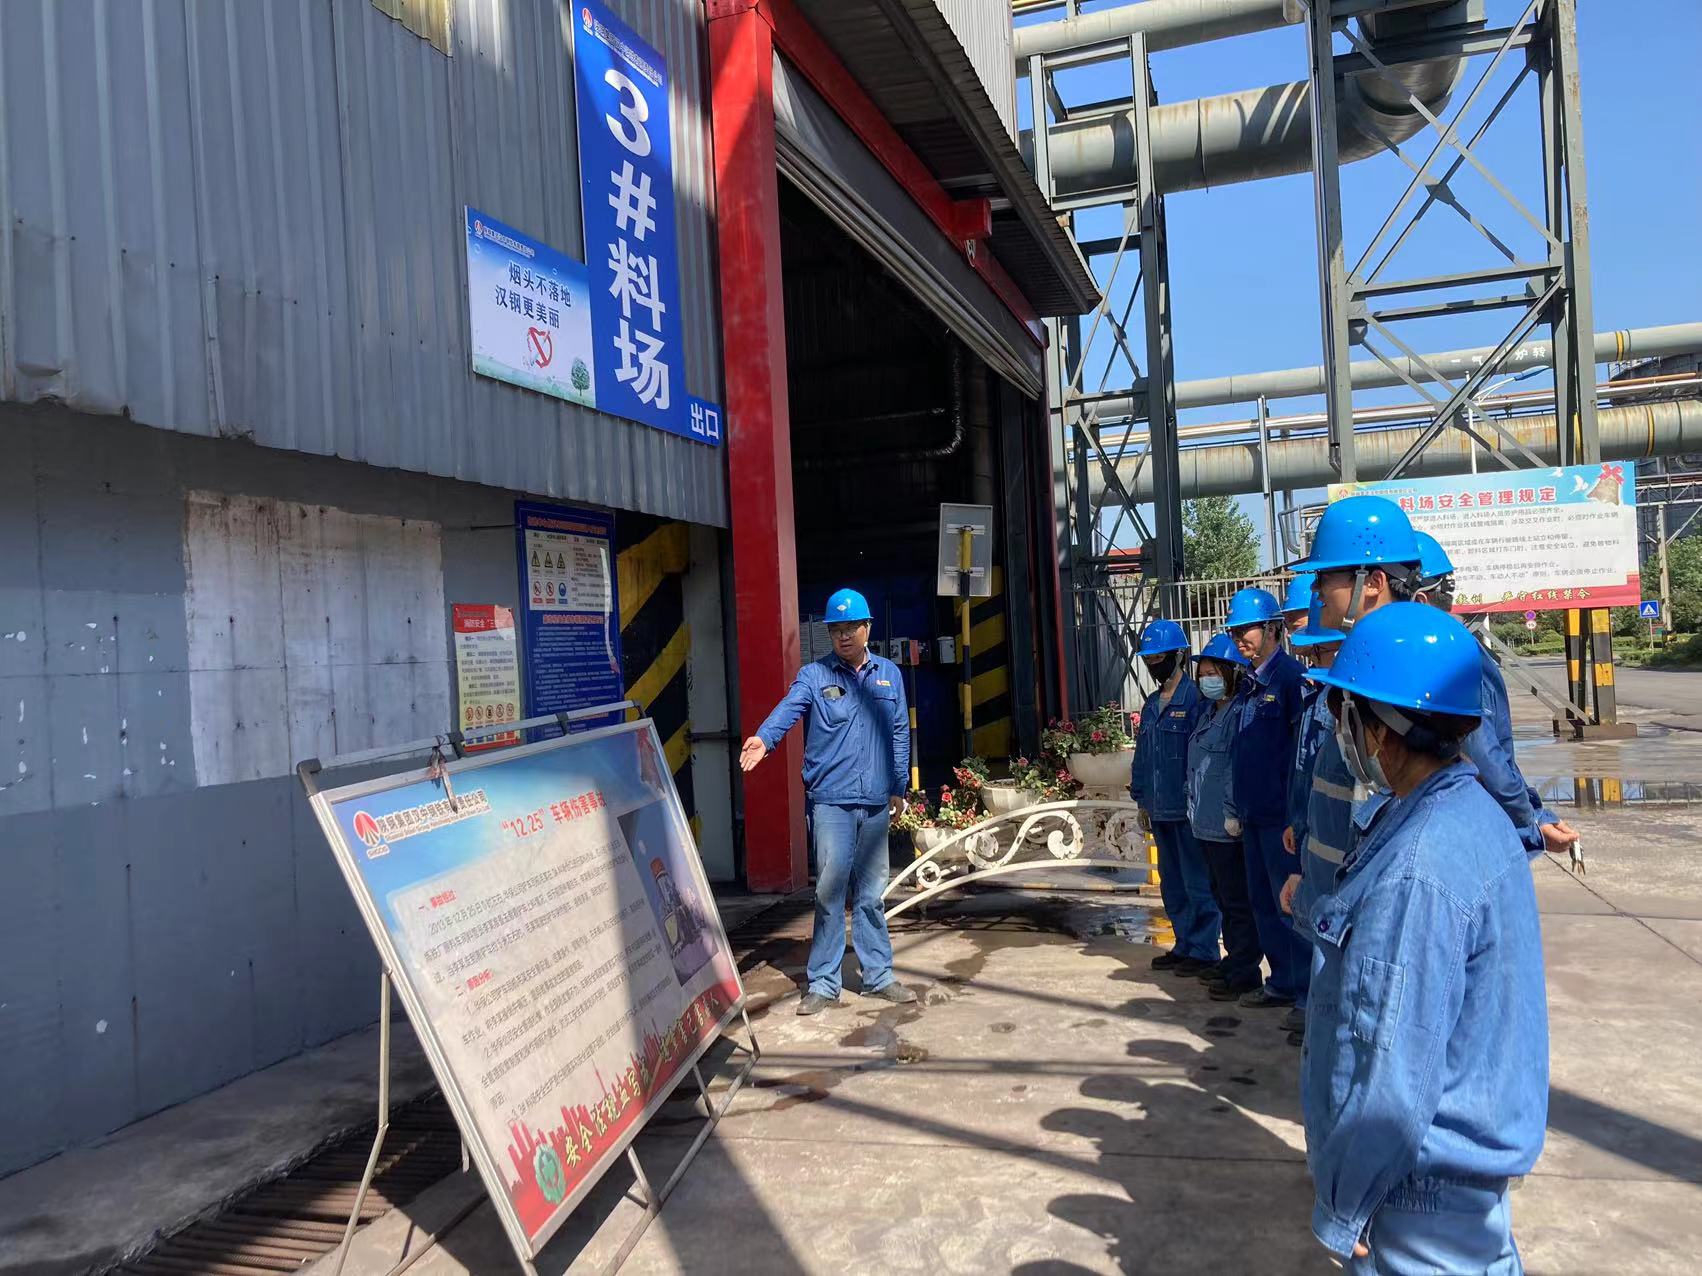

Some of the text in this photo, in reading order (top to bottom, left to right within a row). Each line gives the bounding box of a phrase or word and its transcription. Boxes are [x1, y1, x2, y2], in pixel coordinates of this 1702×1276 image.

[604, 69, 670, 410] 3#料场
[508, 260, 571, 308] 烟头不落地
[495, 285, 560, 329] 汉钢更美丽
[690, 402, 719, 439] 出口
[1399, 487, 1557, 511] 料场安全管理规定
[1502, 588, 1591, 603] 严守红线禁令
[376, 790, 486, 834] 陕钢集团汉中钢铁有责任公司
[550, 791, 607, 824] 车辆伤害事故
[566, 1053, 651, 1167] 安全法规血写成
